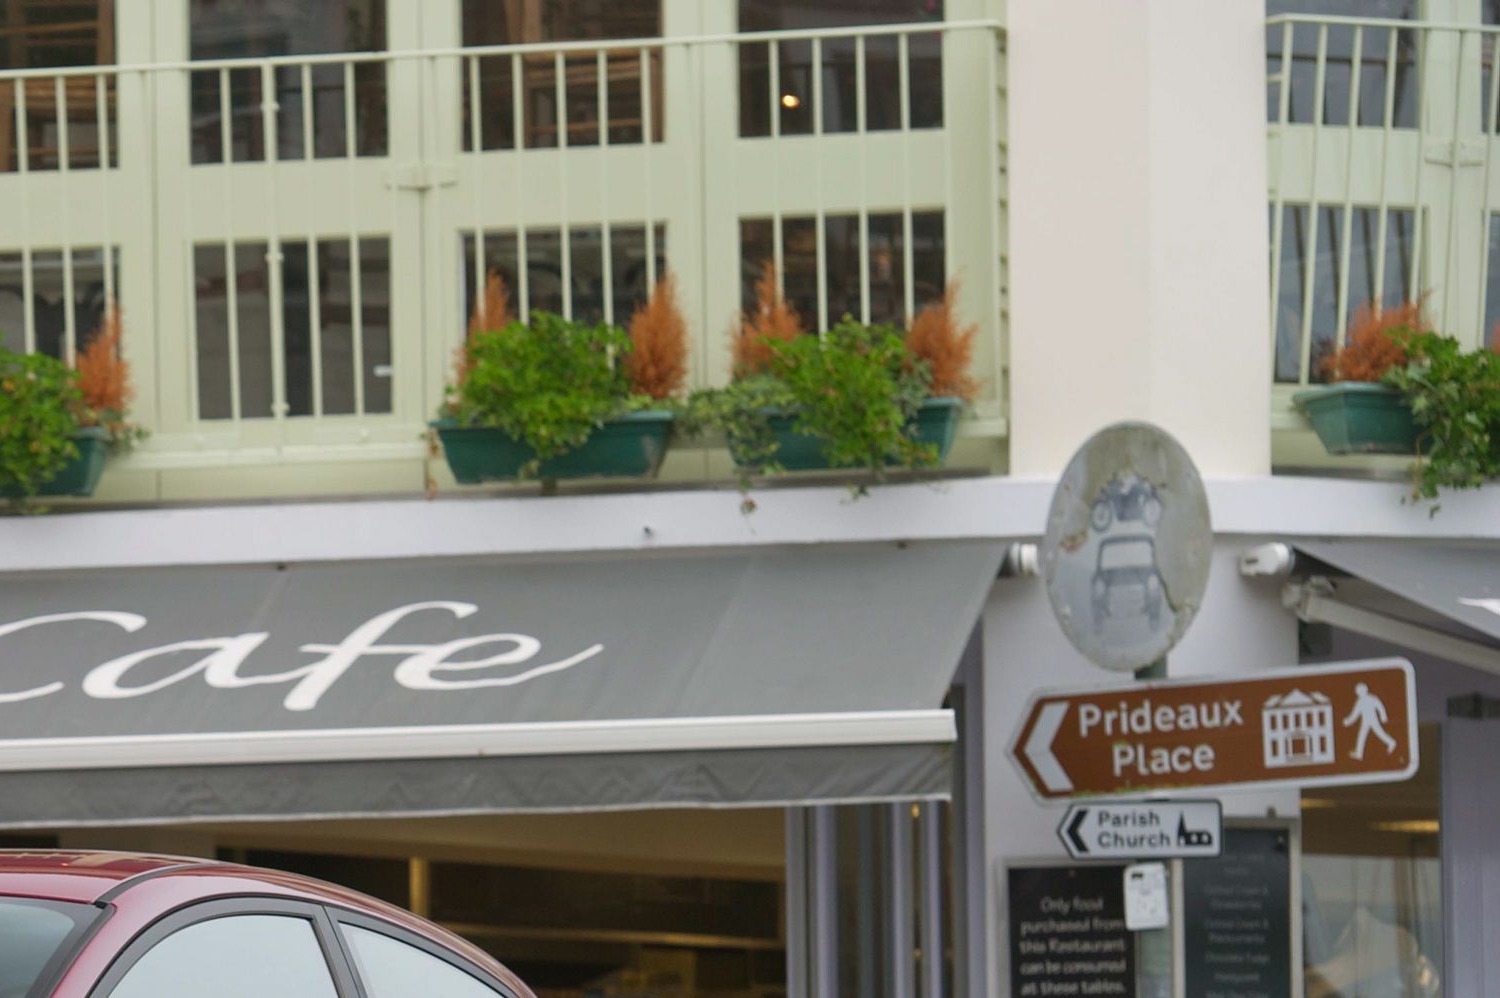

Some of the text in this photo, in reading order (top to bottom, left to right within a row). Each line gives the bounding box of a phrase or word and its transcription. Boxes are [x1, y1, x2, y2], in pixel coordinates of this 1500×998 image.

[1078, 699, 1244, 738] Prideaux
[1112, 743, 1215, 777] Place
[1098, 810, 1160, 828] Parish
[1098, 831, 1170, 849] Church
[1040, 896, 1104, 915] Only food
[1020, 918, 1090, 936] purchased
